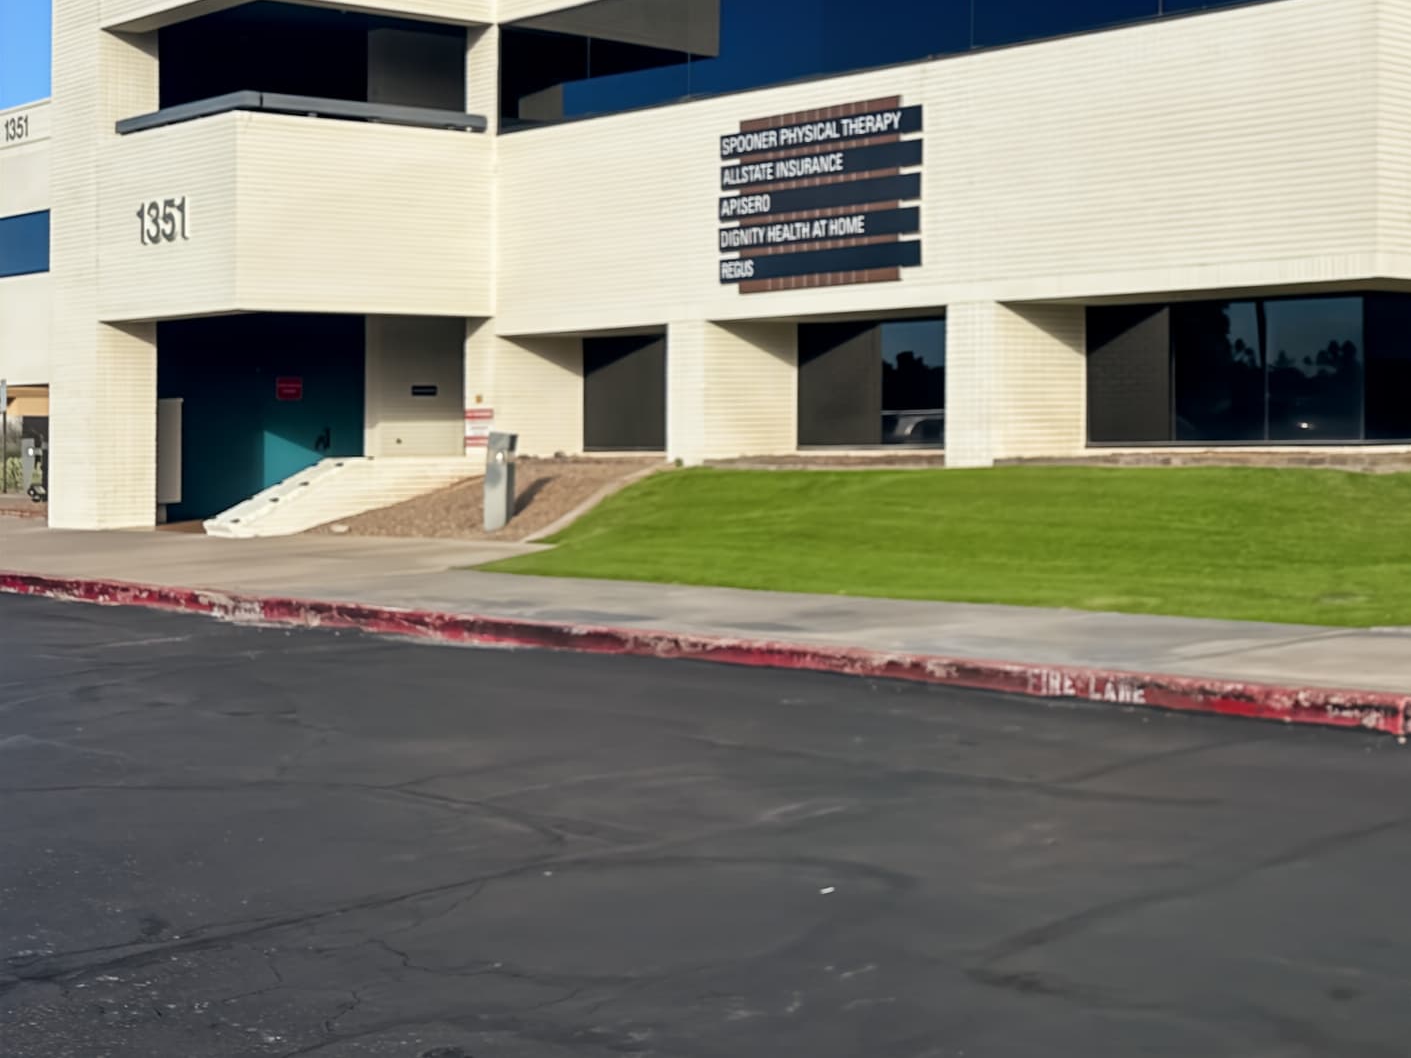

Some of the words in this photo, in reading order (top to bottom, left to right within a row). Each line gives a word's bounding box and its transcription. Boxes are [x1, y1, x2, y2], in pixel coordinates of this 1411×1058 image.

[4, 115, 29, 142] 1351
[721, 130, 777, 155] SPOONER
[780, 120, 840, 146] PHYSICAL
[841, 111, 902, 137] THERAPY
[722, 162, 774, 185] ALLSTATE
[776, 153, 844, 179] INSURANCE
[136, 196, 189, 245] 1351
[720, 194, 771, 217] APISERO
[720, 225, 766, 248] DIGNITY
[767, 221, 810, 244] HEALTH
[812, 219, 827, 237] AT
[829, 215, 865, 236] HOME
[720, 260, 754, 279] REGUS
[1026, 668, 1076, 696] FIRE
[1088, 674, 1146, 704] LANE
